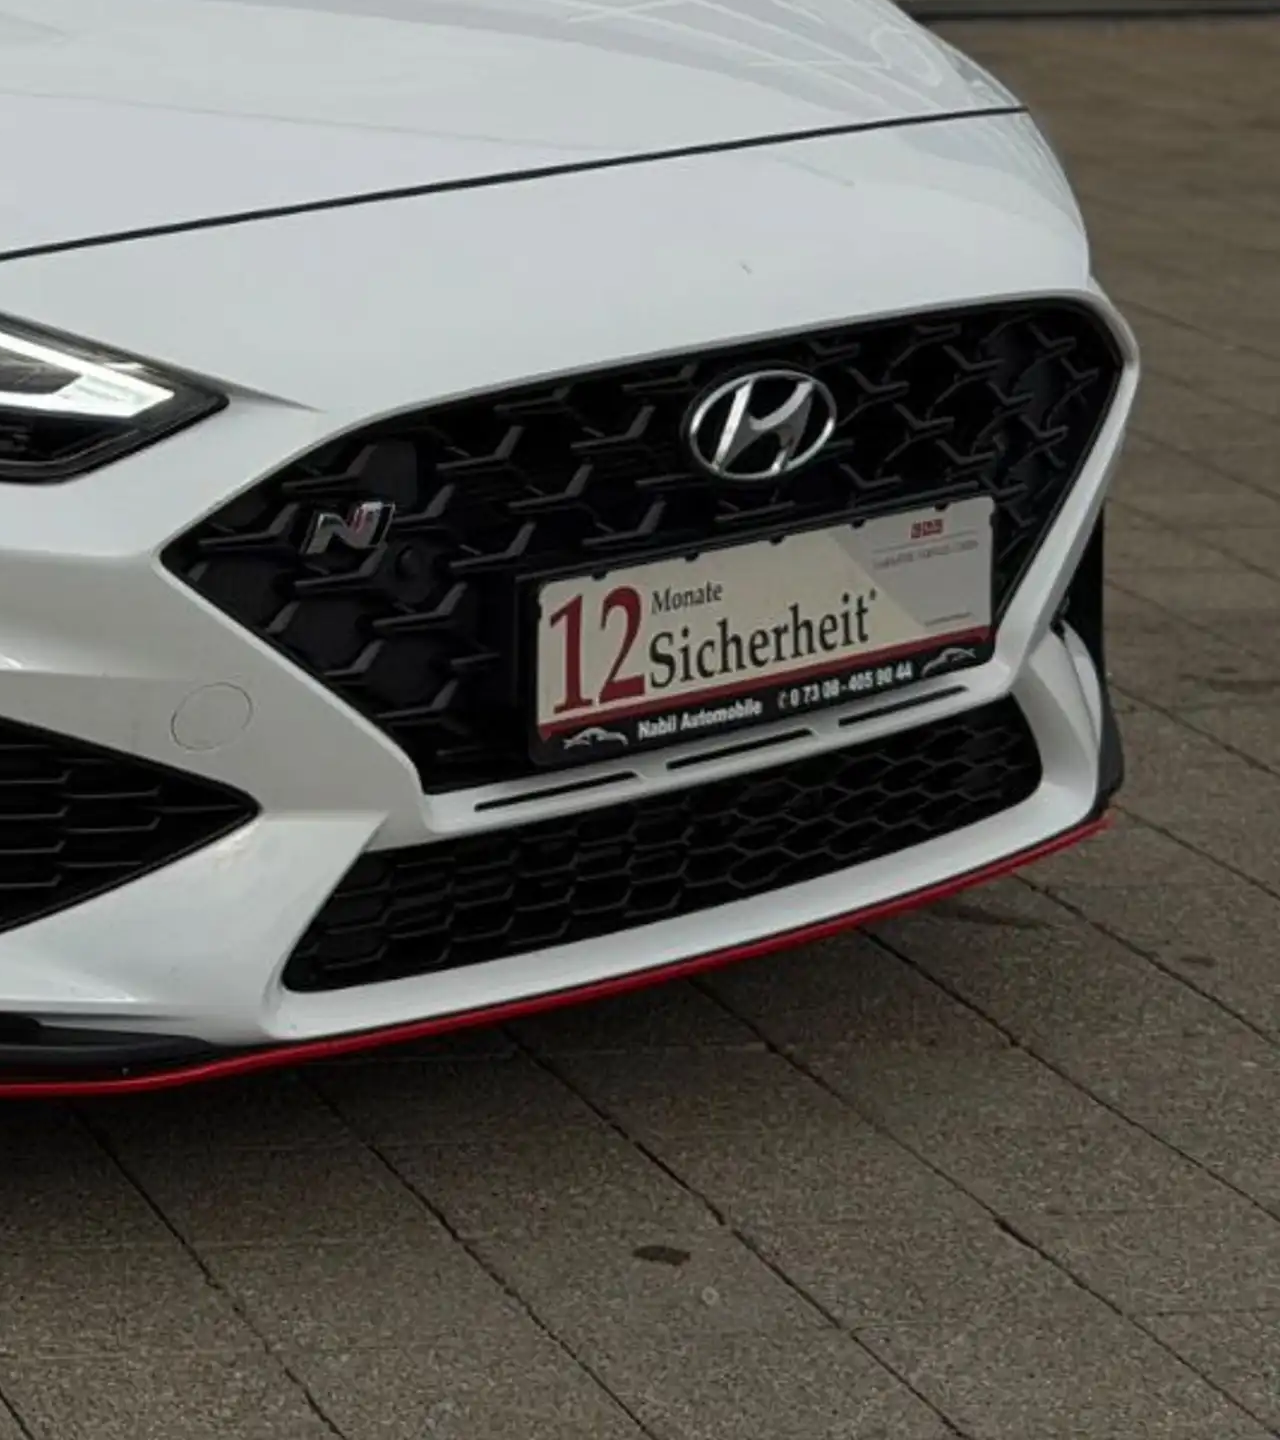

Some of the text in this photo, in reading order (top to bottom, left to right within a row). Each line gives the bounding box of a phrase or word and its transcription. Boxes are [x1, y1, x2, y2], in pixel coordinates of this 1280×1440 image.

[650, 580, 724, 615] Monate
[549, 584, 646, 715] 12
[637, 698, 764, 740] Nabil Automobile
